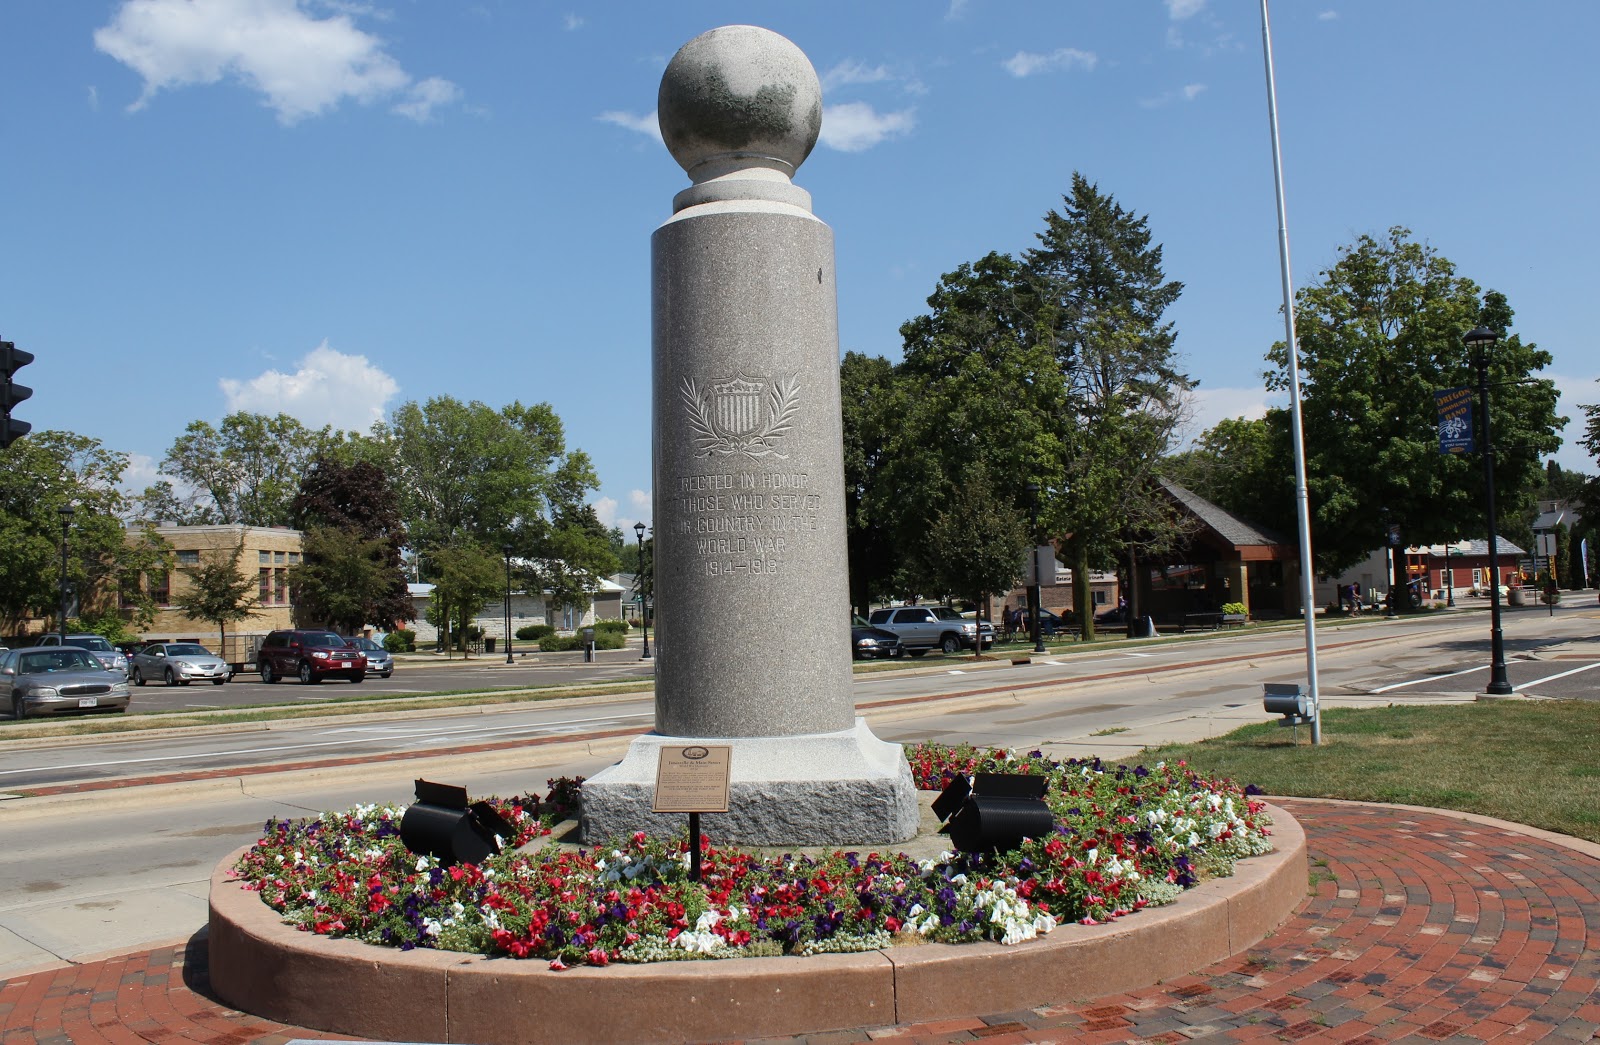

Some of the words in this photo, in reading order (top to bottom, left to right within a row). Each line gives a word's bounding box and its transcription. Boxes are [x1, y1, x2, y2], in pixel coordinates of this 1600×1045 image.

[1437, 389, 1471, 406] OREGON
[1439, 397, 1472, 414] COMMUNITY
[1445, 408, 1467, 420] BAND
[740, 473, 755, 489] IN
[762, 472, 808, 488] HONOR
[682, 495, 725, 513] THOSE
[731, 494, 763, 511] WHO
[771, 494, 821, 510] SERVED
[697, 515, 765, 533] COUNTRY
[772, 515, 786, 531] IN
[792, 515, 817, 531] THE
[697, 537, 746, 554] WORLD
[753, 537, 785, 553] WAR
